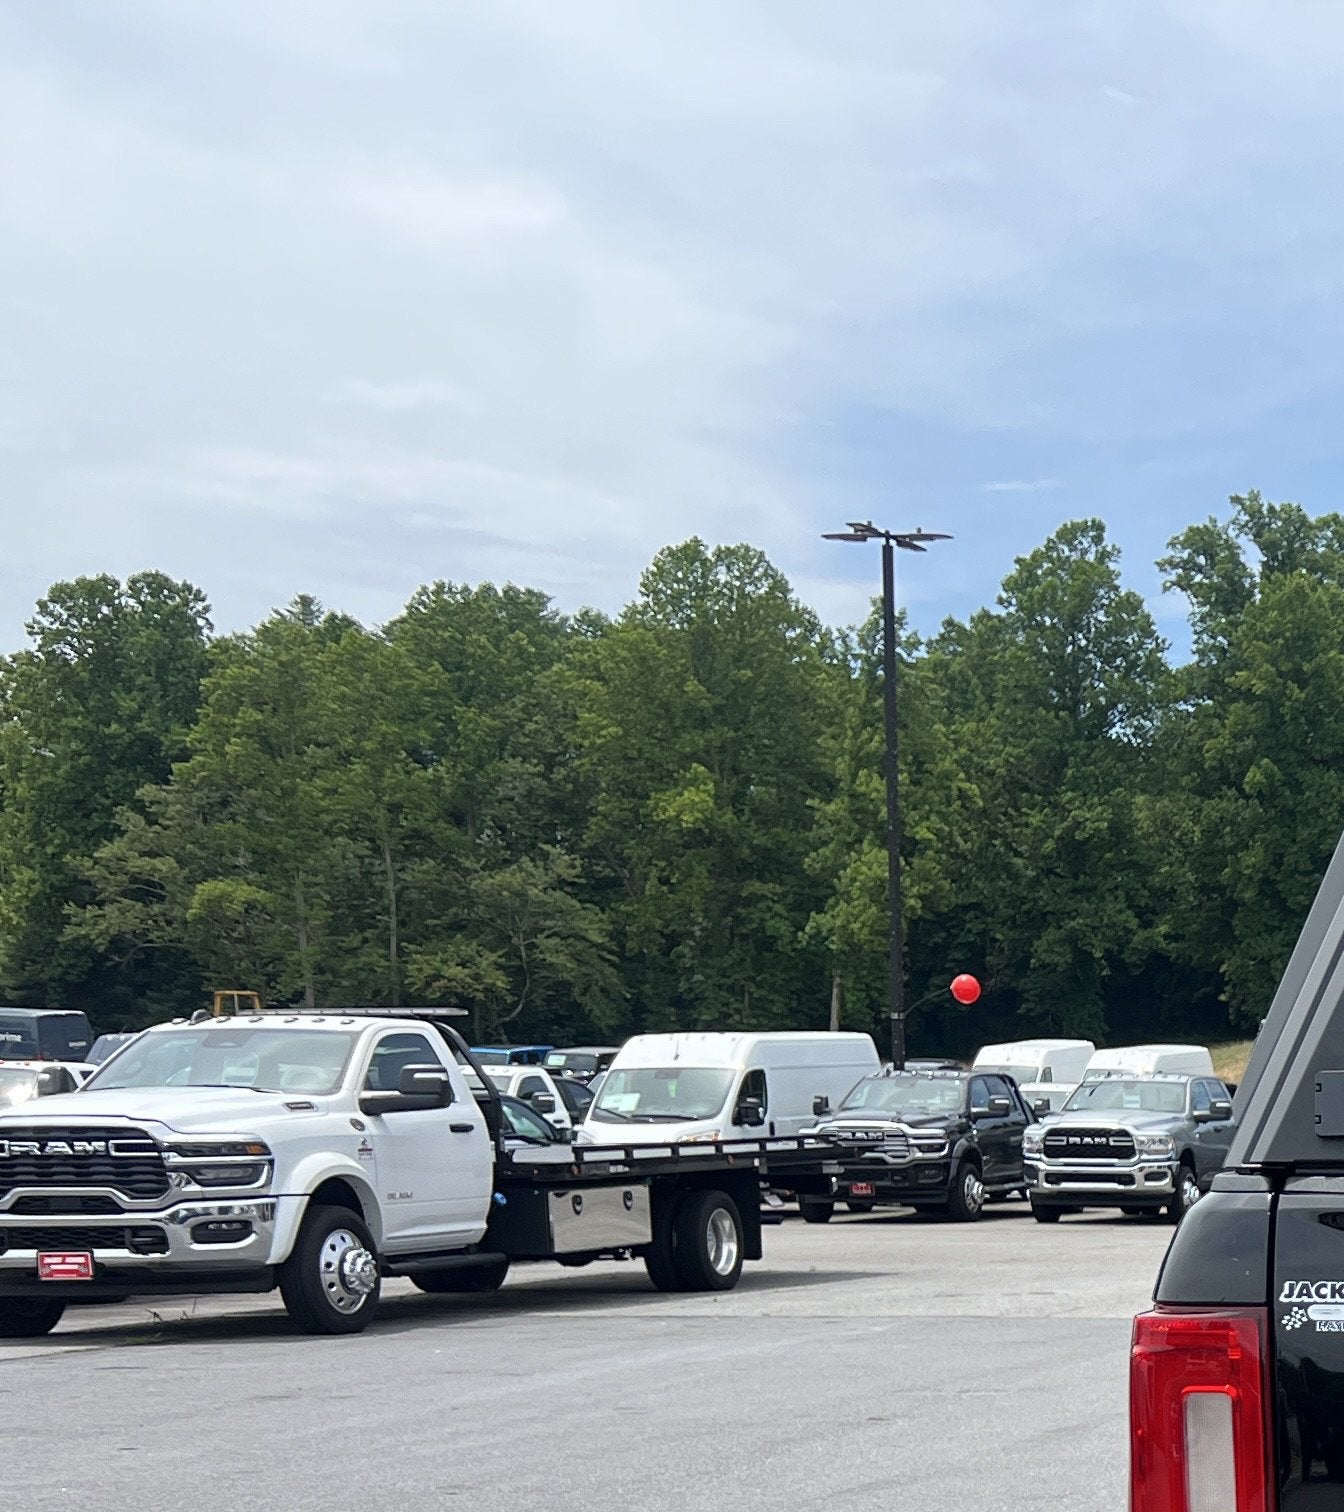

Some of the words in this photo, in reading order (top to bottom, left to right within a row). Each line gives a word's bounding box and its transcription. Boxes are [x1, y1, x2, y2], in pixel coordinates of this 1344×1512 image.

[837, 1130, 885, 1141] RAM
[1068, 1136, 1108, 1146] RAM
[9, 1140, 107, 1156] RAM
